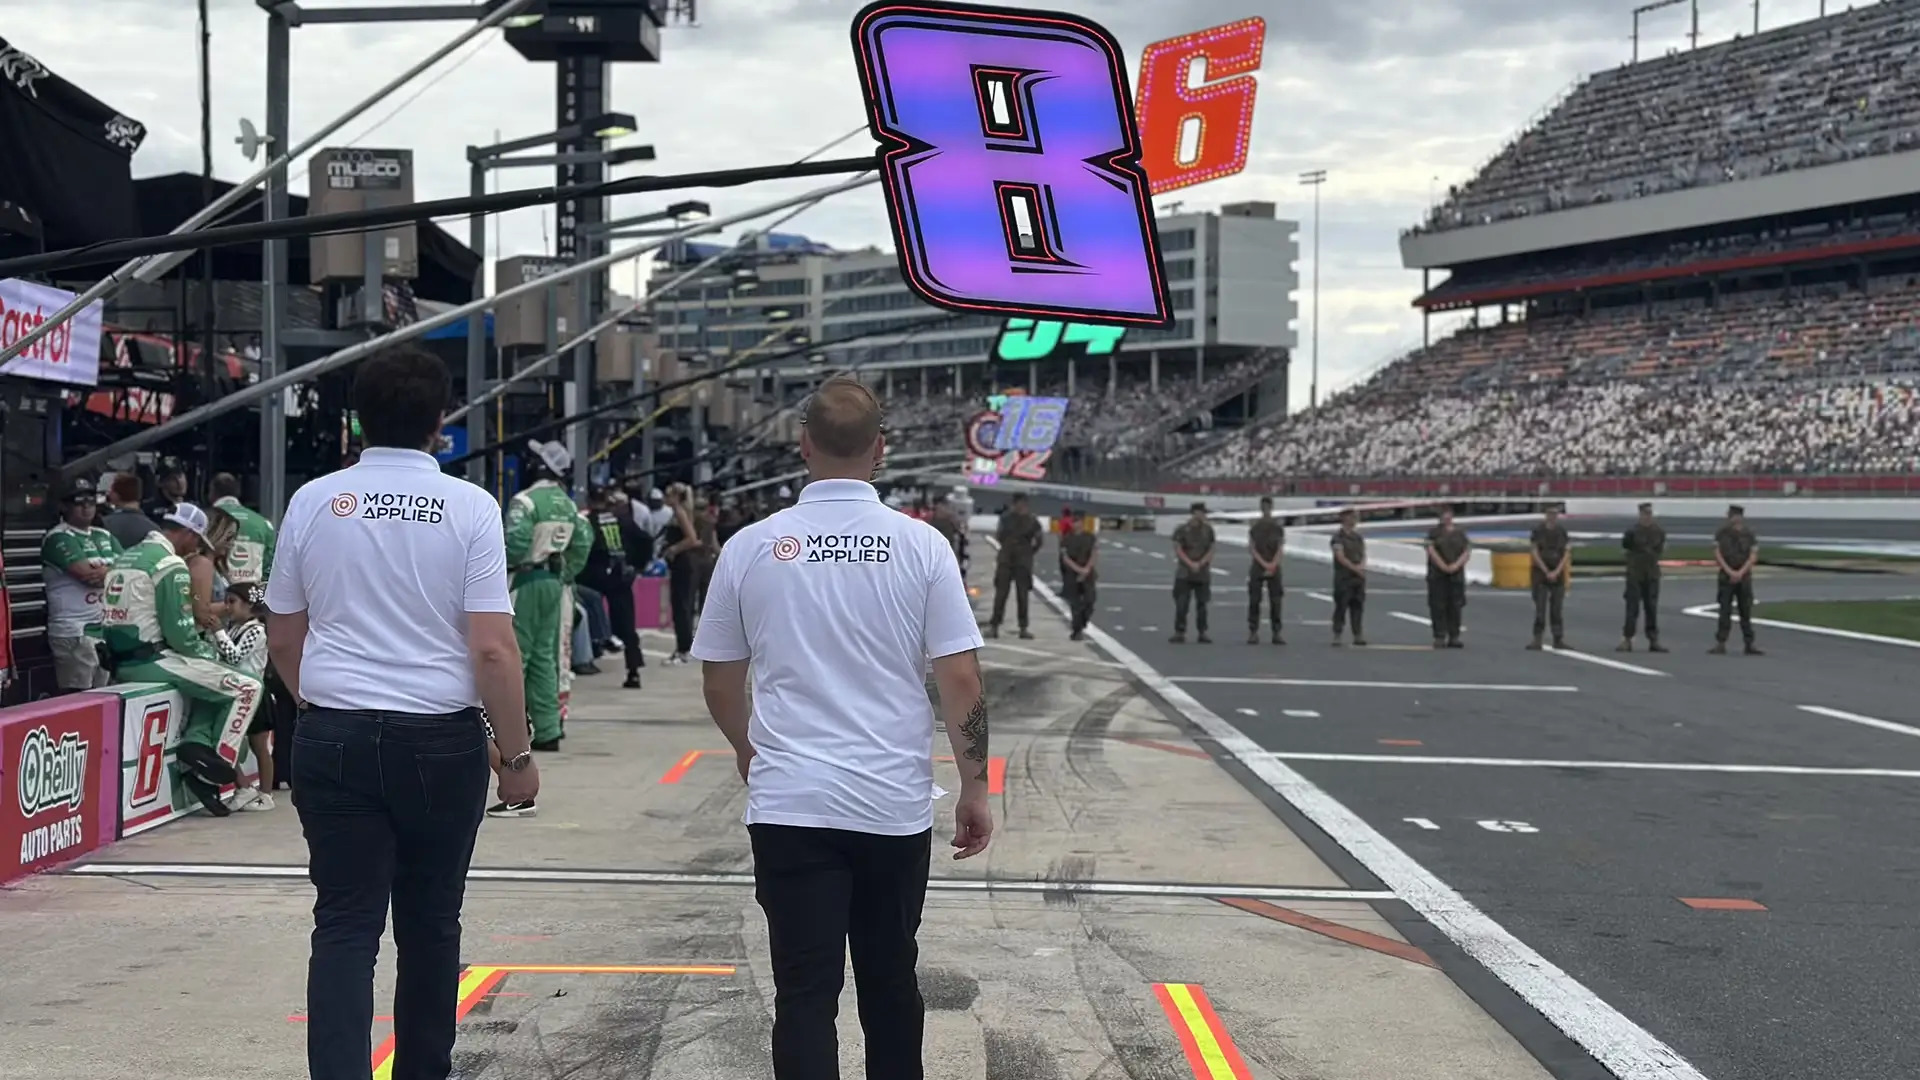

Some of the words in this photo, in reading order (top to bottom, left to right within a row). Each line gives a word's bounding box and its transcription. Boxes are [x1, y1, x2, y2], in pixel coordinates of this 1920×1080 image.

[1134, 16, 1265, 197] 6
[851, 0, 1174, 330] 8
[0, 295, 72, 363] astrol
[361, 507, 443, 524] APPLIED
[363, 492, 445, 511] MOTION
[806, 534, 891, 548] MOTION
[806, 549, 890, 562] APPLIED
[20, 727, 87, 814] O'Reilly
[131, 704, 171, 806] 6
[20, 826, 49, 864] AUTO
[50, 814, 82, 853] PARTS
